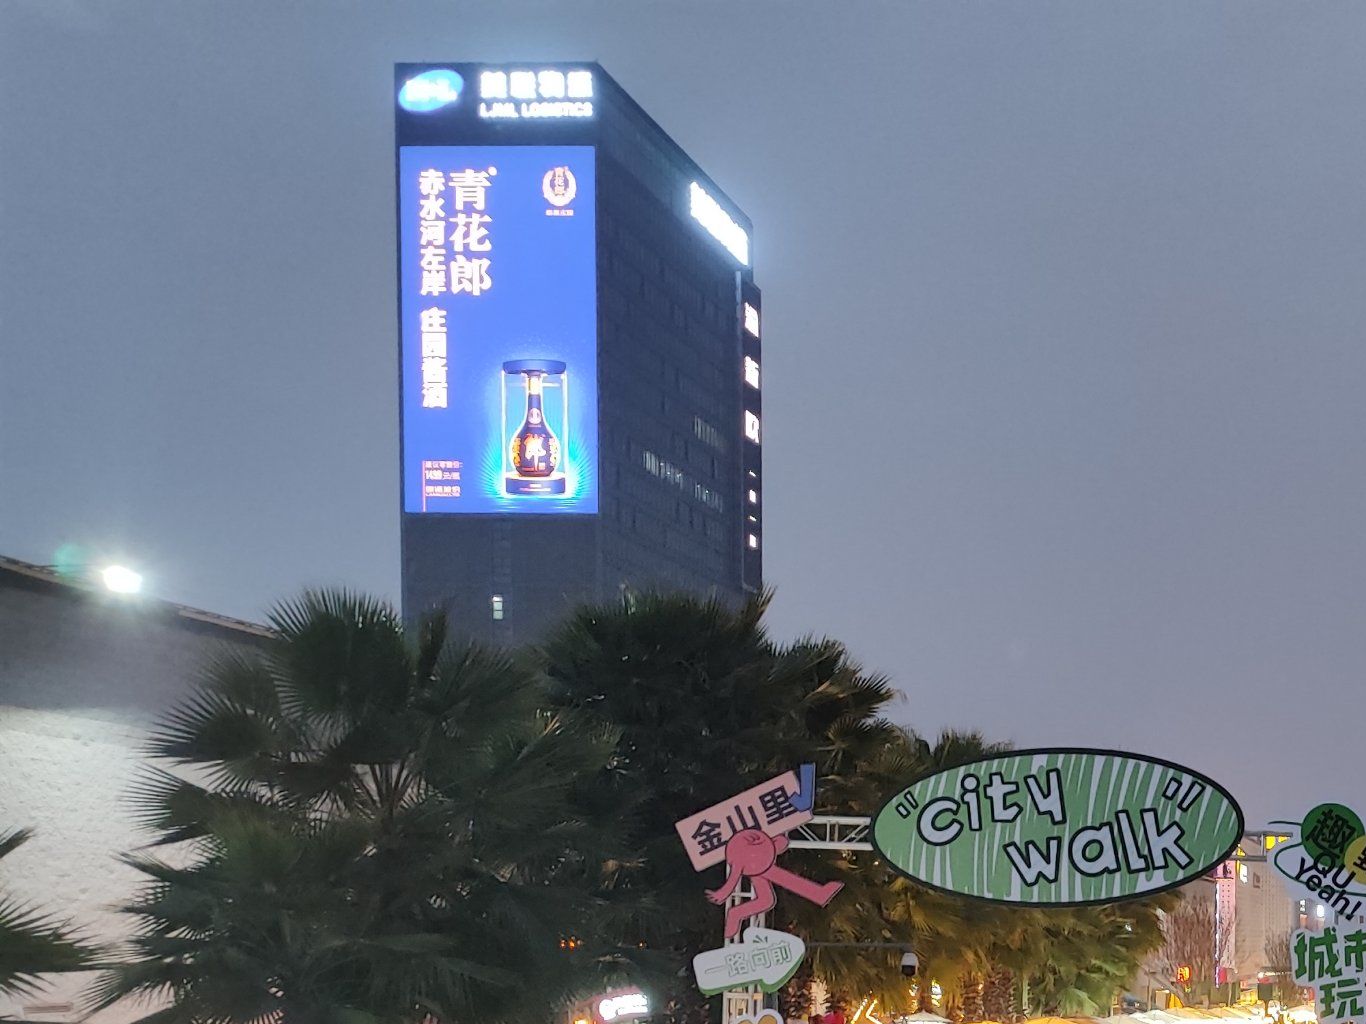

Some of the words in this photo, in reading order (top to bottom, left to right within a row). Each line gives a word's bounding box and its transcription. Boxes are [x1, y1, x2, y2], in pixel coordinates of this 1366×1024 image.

[418, 168, 447, 296] 赤水河左岸
[449, 168, 493, 296] 青花郎
[1296, 857, 1363, 921] Yeah!
[704, 941, 793, 978] 一路向前
